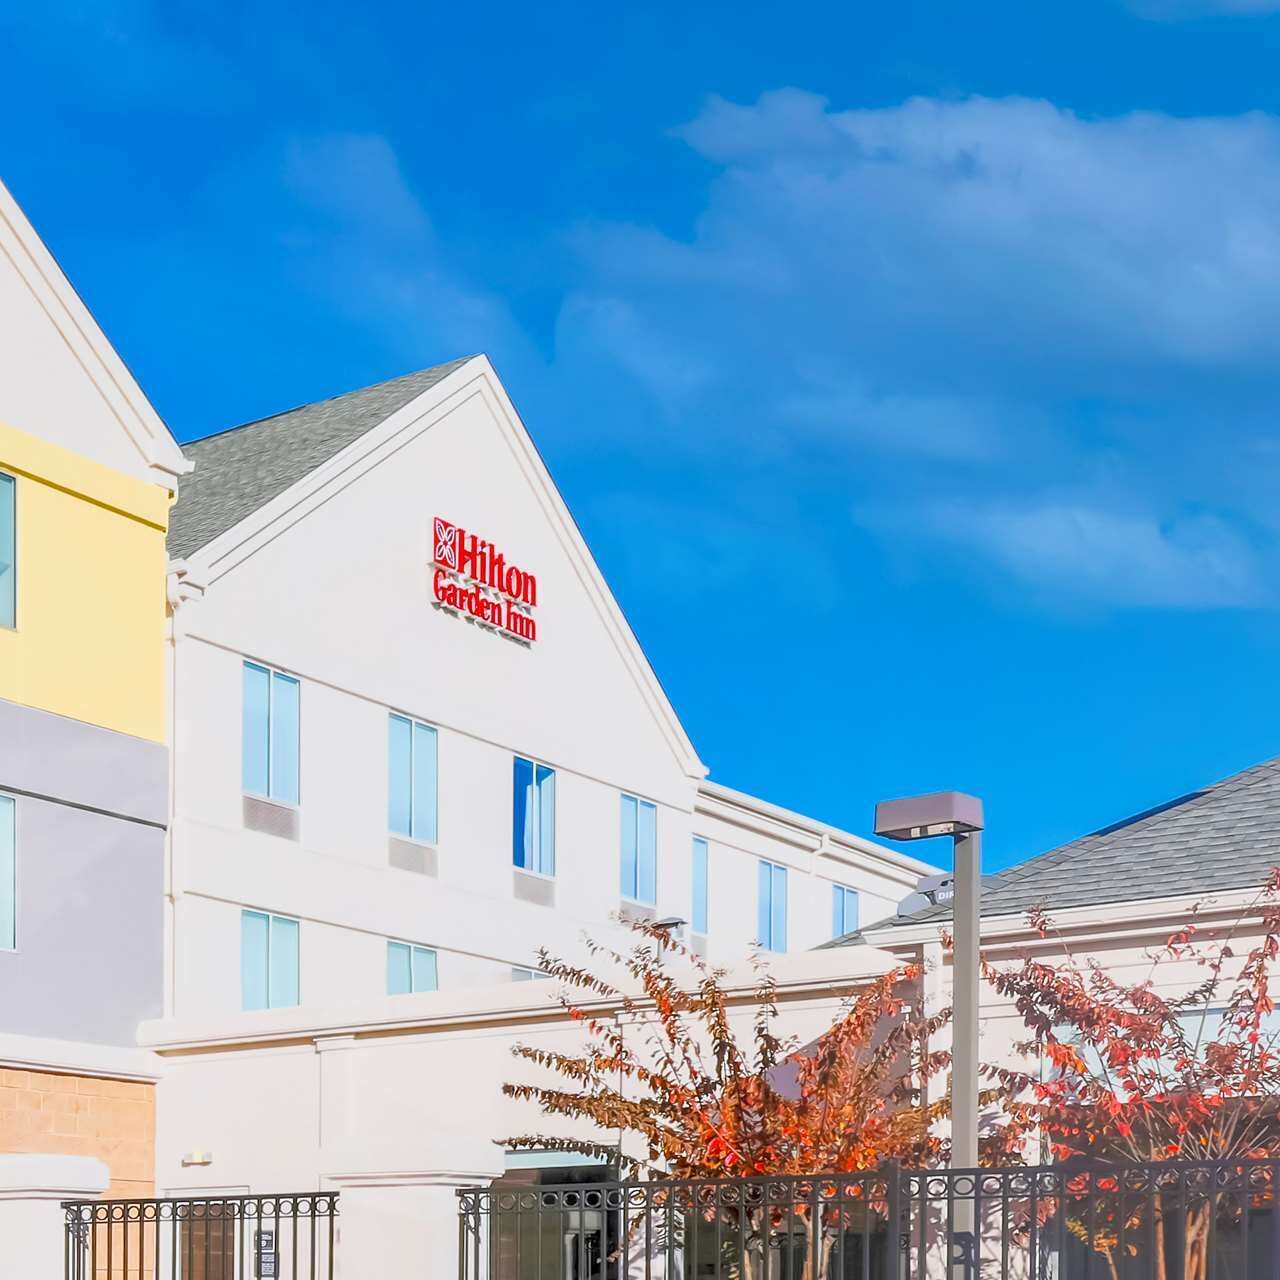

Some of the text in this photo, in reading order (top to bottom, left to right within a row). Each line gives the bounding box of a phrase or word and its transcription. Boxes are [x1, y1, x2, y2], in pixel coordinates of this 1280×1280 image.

[433, 568, 536, 641] Garden Inn
[456, 528, 537, 607] Hilton
